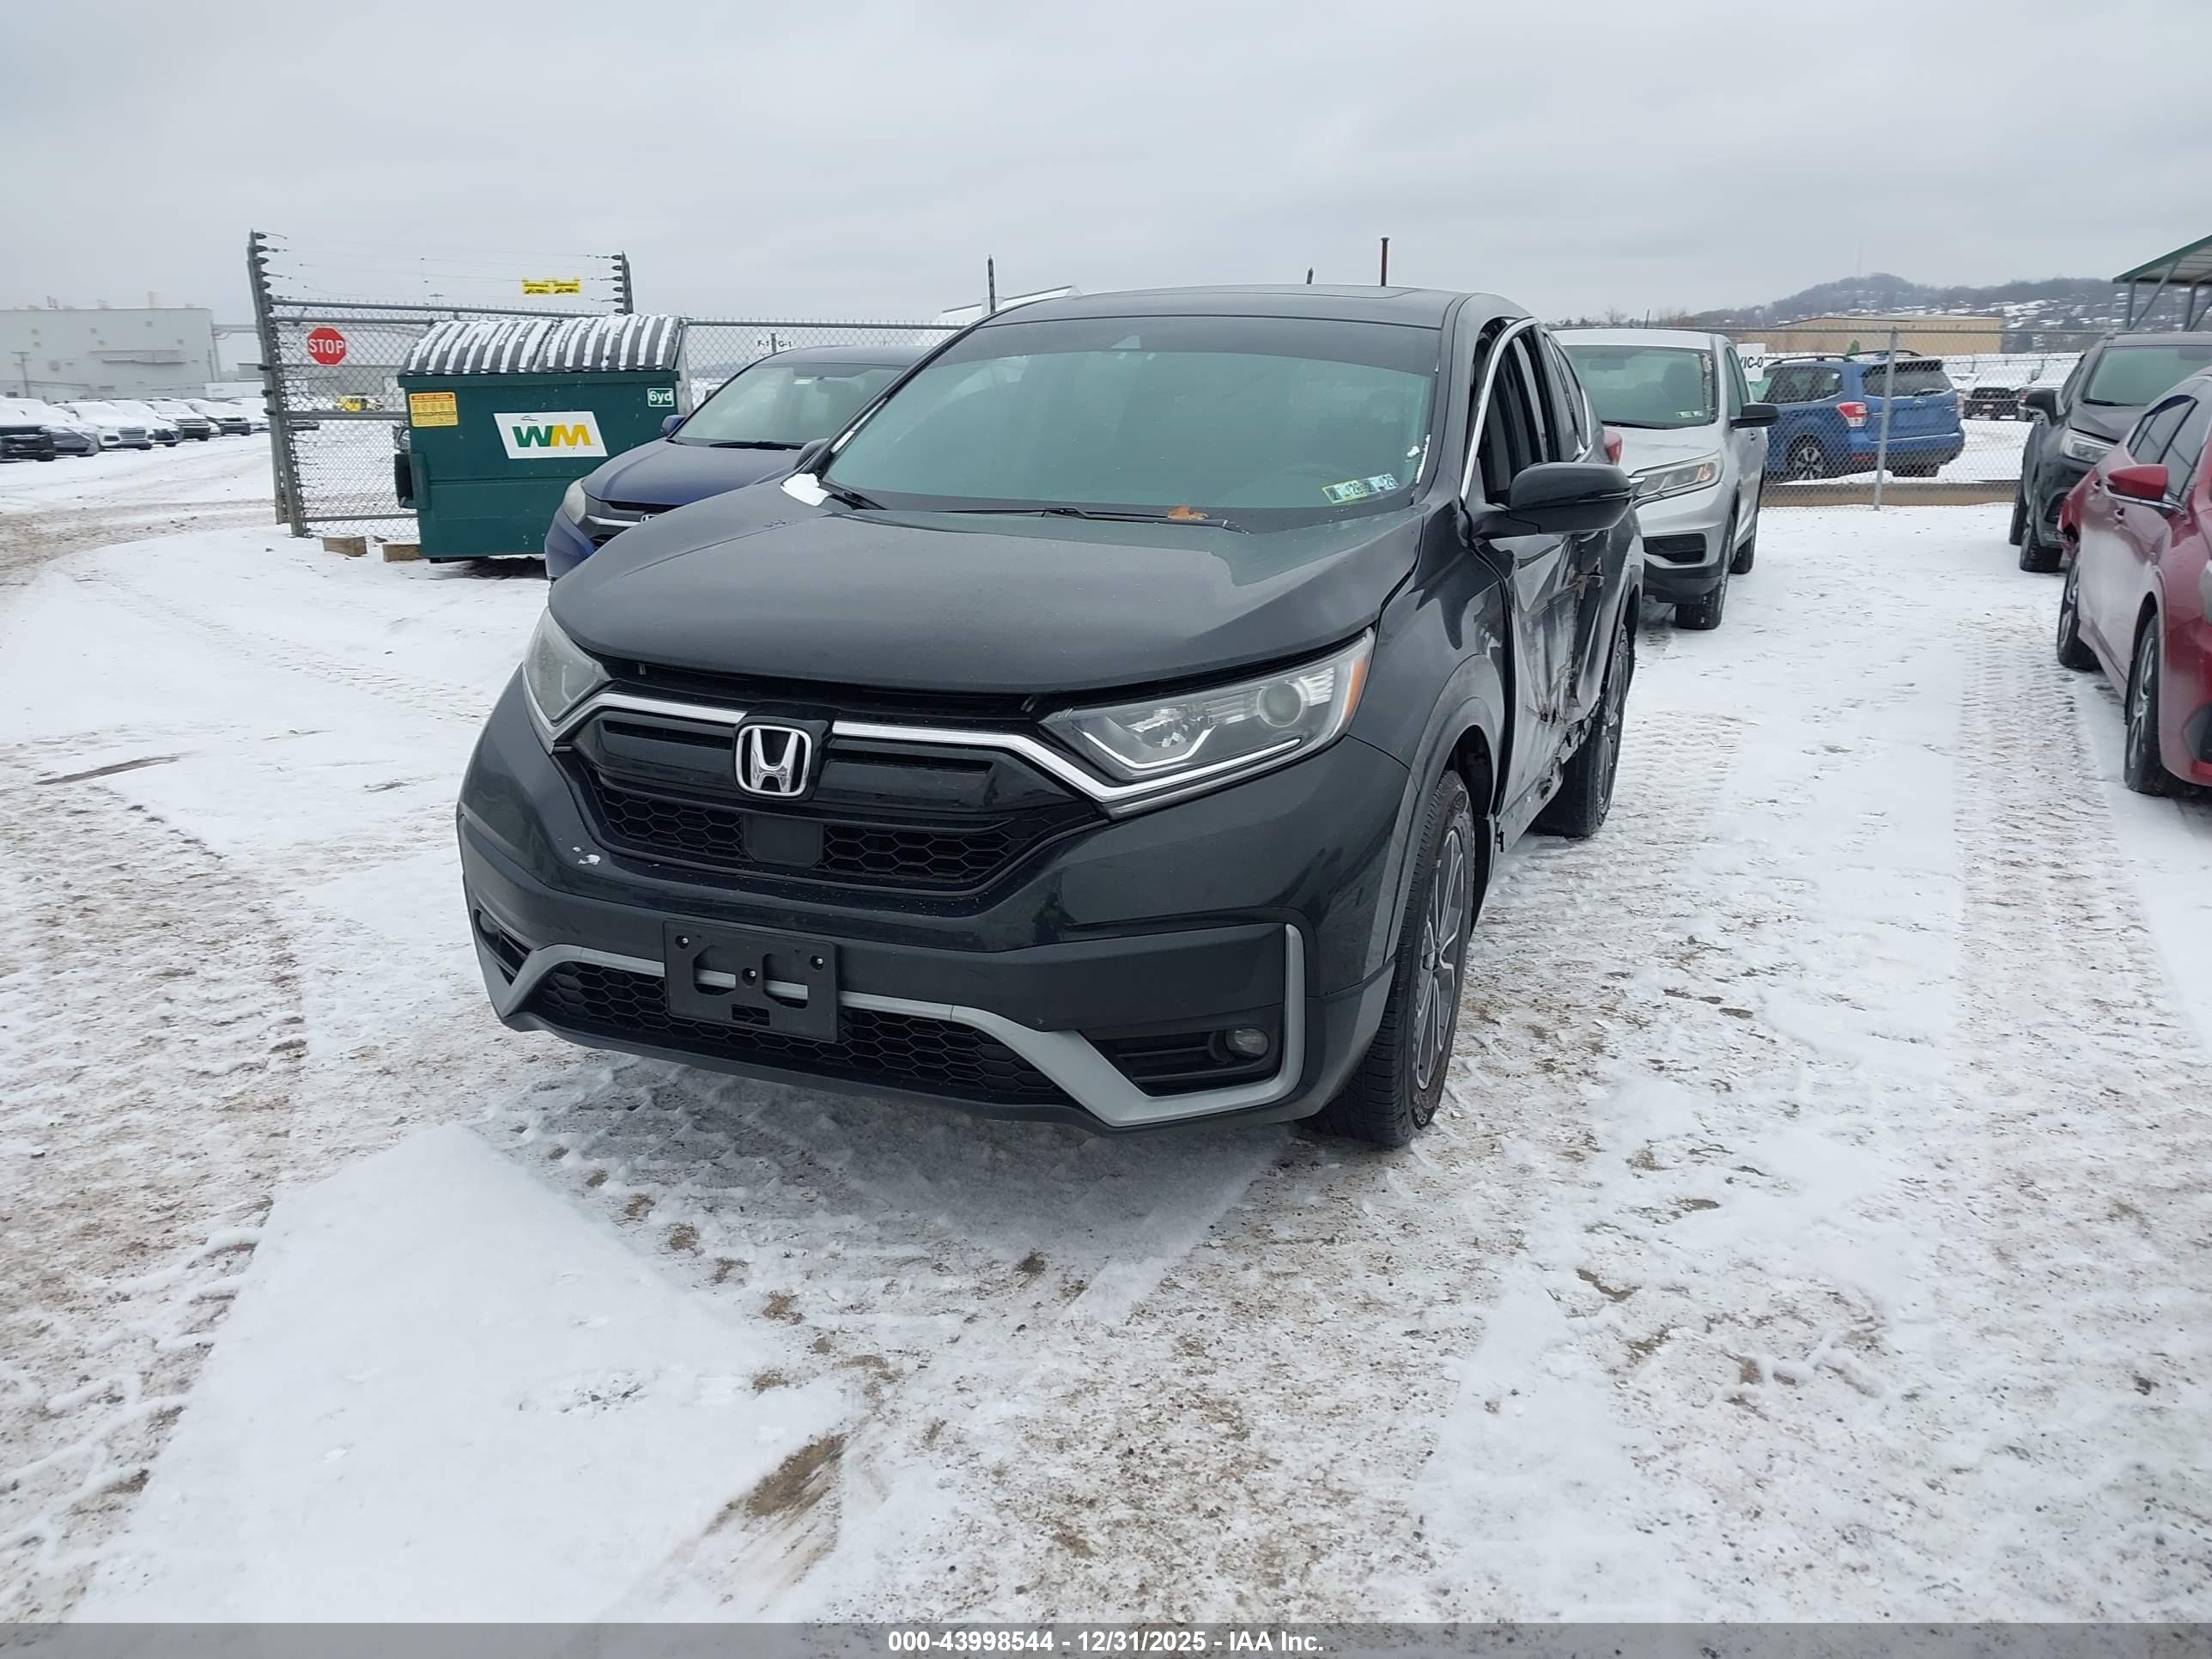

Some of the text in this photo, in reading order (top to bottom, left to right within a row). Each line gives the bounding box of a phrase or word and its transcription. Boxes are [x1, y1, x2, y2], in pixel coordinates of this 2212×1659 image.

[309, 338, 344, 354] STOP
[650, 390, 673, 404] 6yd
[512, 424, 592, 447] WM
